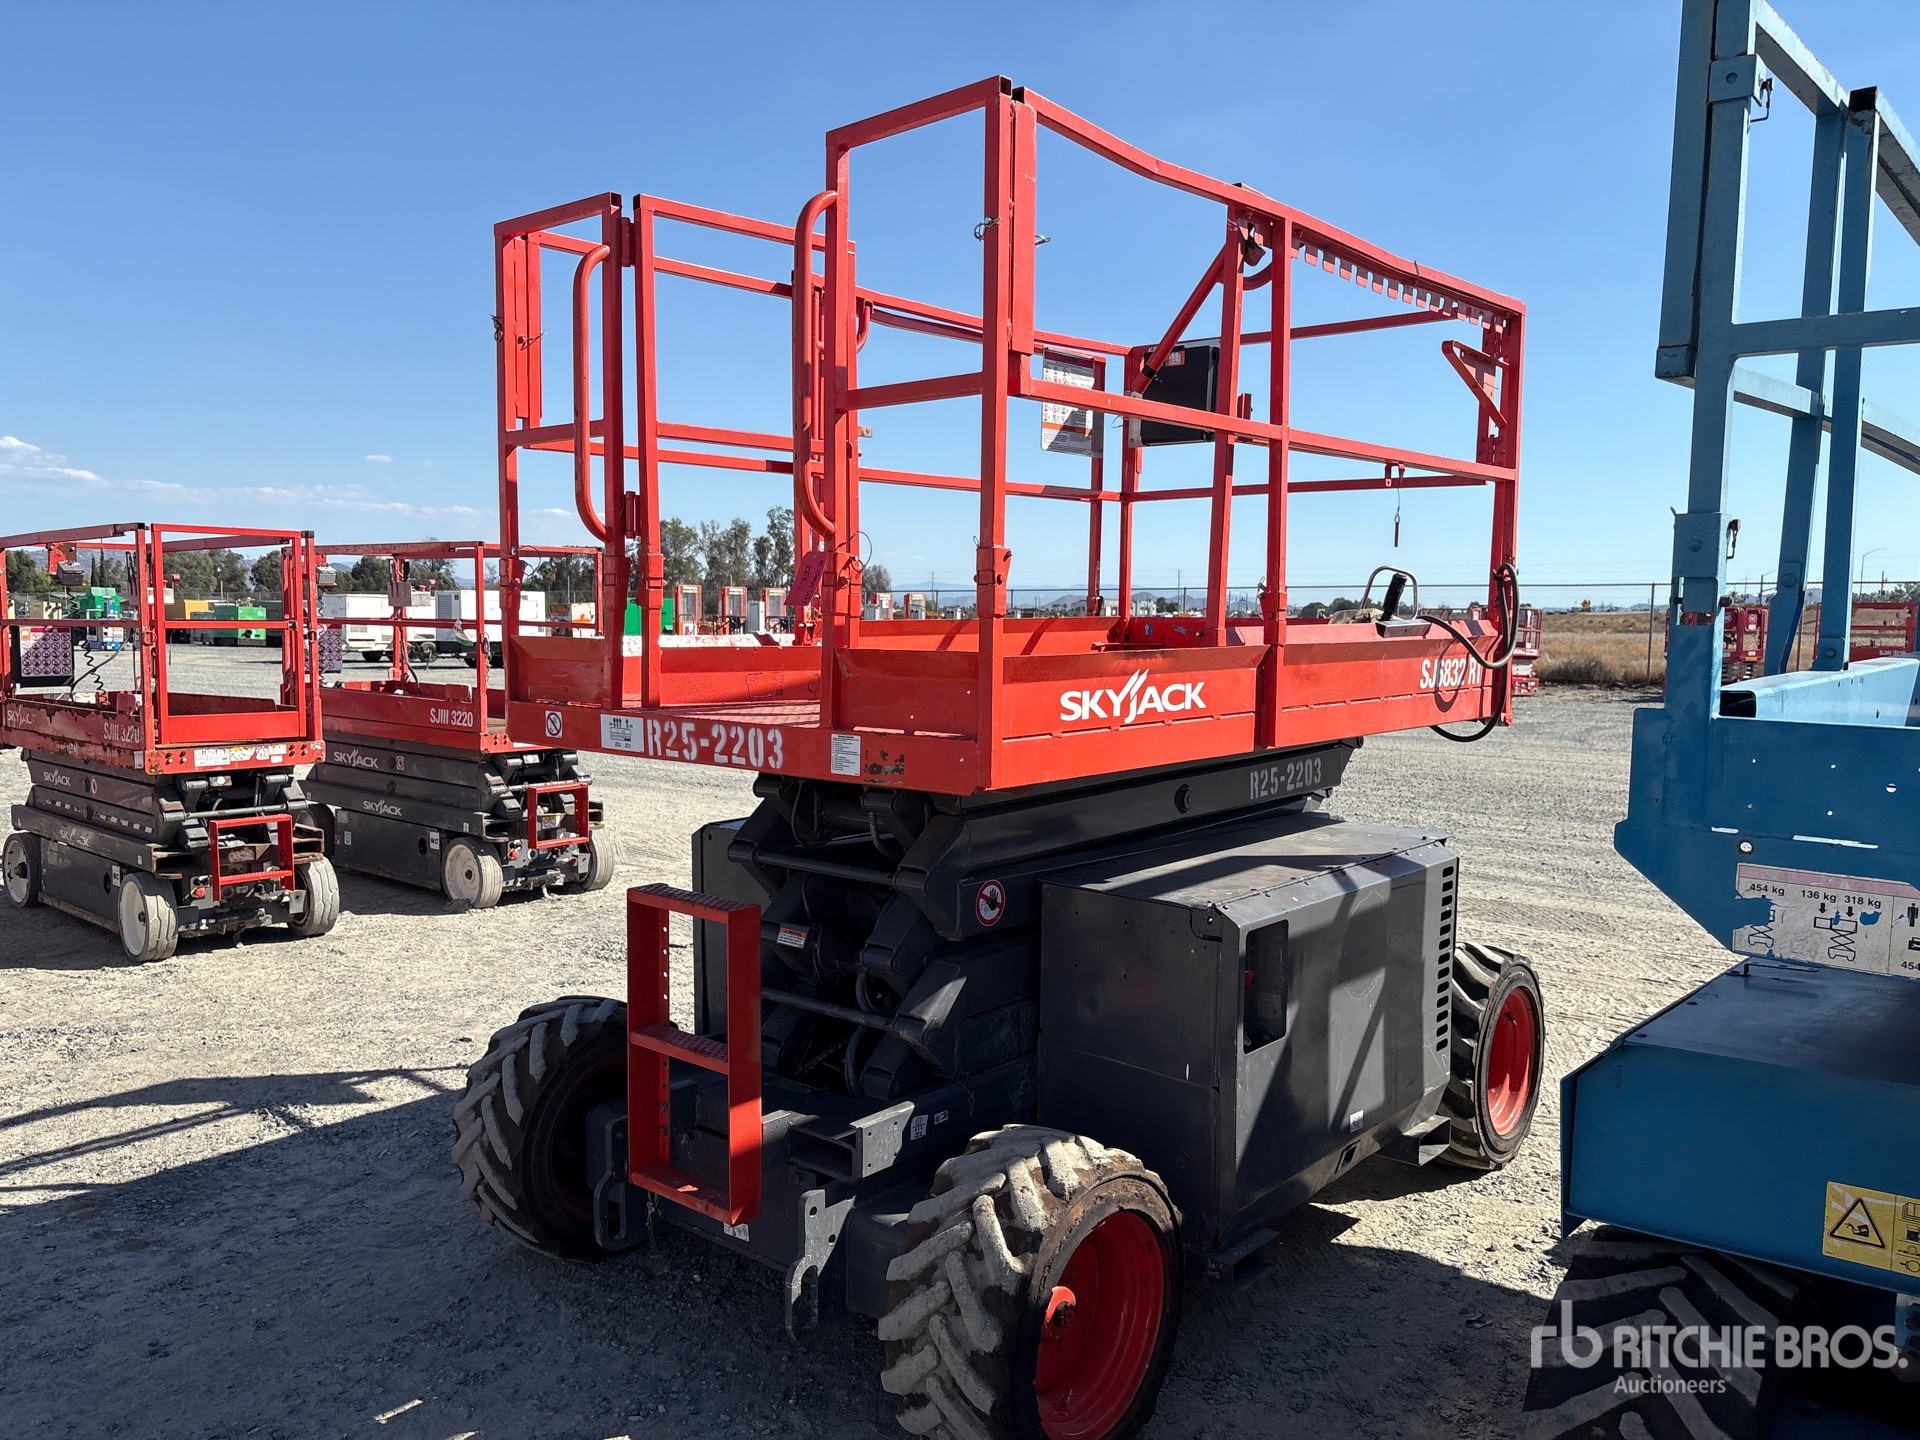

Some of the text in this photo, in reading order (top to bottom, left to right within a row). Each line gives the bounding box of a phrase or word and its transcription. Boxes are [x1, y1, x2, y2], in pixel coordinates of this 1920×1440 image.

[1420, 658, 1466, 689] SJ6832
[1060, 668, 1207, 724] SKYJACK
[430, 707, 474, 728] SJIII 3220
[646, 719, 784, 769] R25-2203
[333, 749, 379, 769] SKYJACK
[43, 769, 72, 787] SKYJACK
[1250, 757, 1322, 800] R25-2203
[363, 799, 402, 816] SKYJACK
[1750, 883, 1785, 897] 454 kg
[1801, 889, 1837, 904] 136 kg
[1844, 895, 1882, 909] 318 kg
